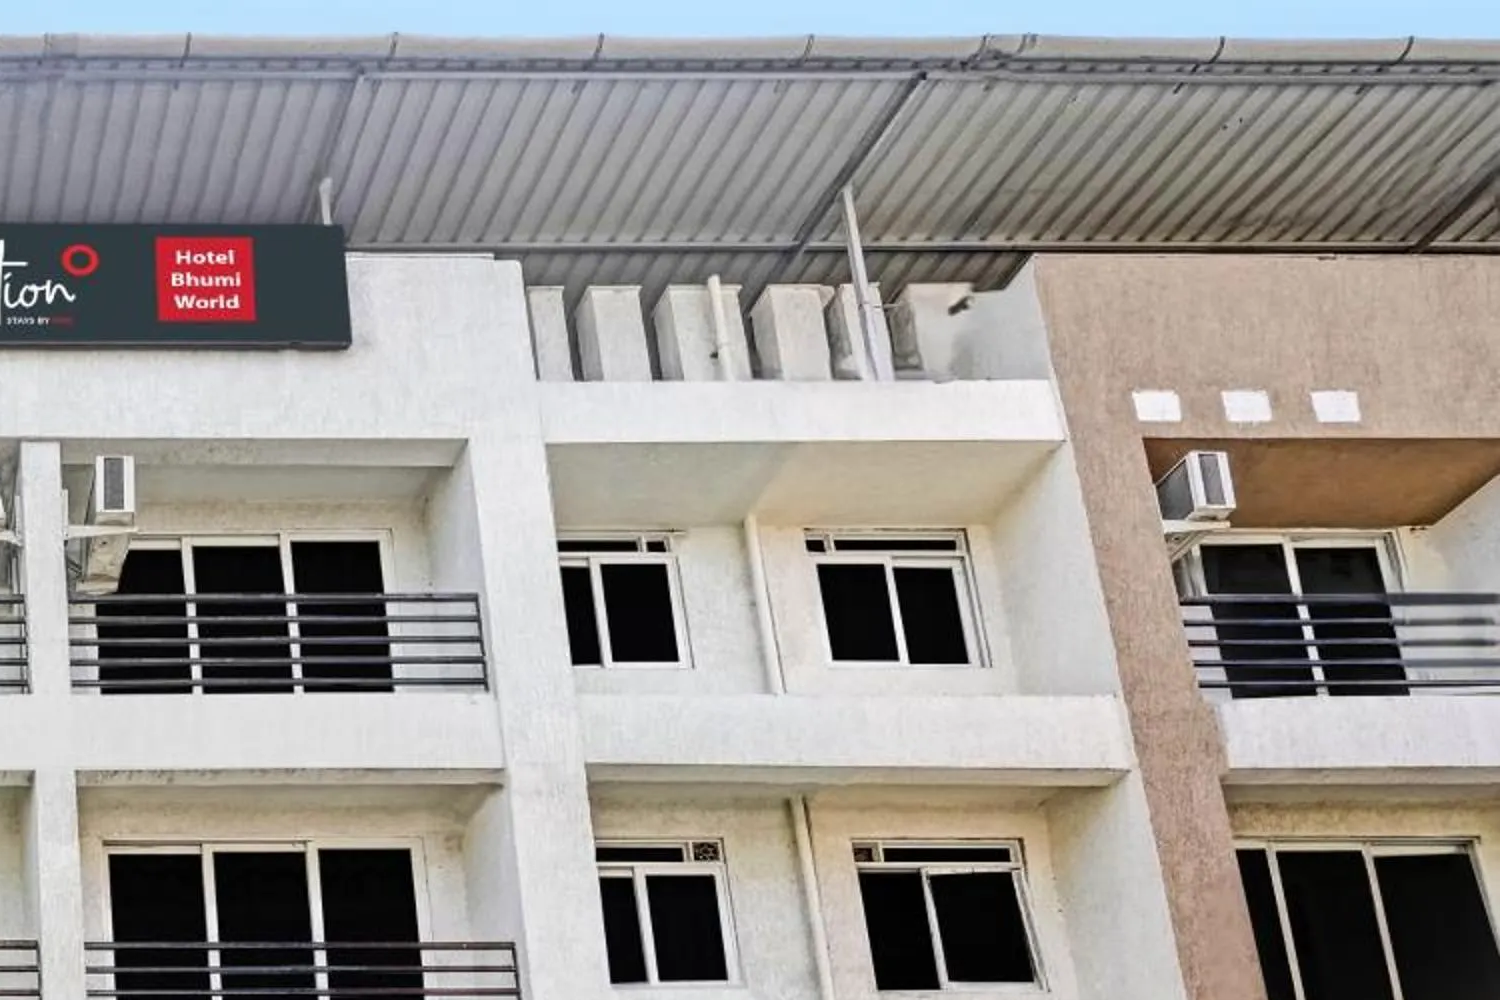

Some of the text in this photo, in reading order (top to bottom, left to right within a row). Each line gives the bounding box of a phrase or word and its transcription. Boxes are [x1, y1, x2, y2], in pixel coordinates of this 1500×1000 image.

[175, 249, 235, 265] Hotel
[171, 271, 241, 287] Bhumi
[173, 294, 240, 309] World
[6, 316, 35, 325] STAYS
